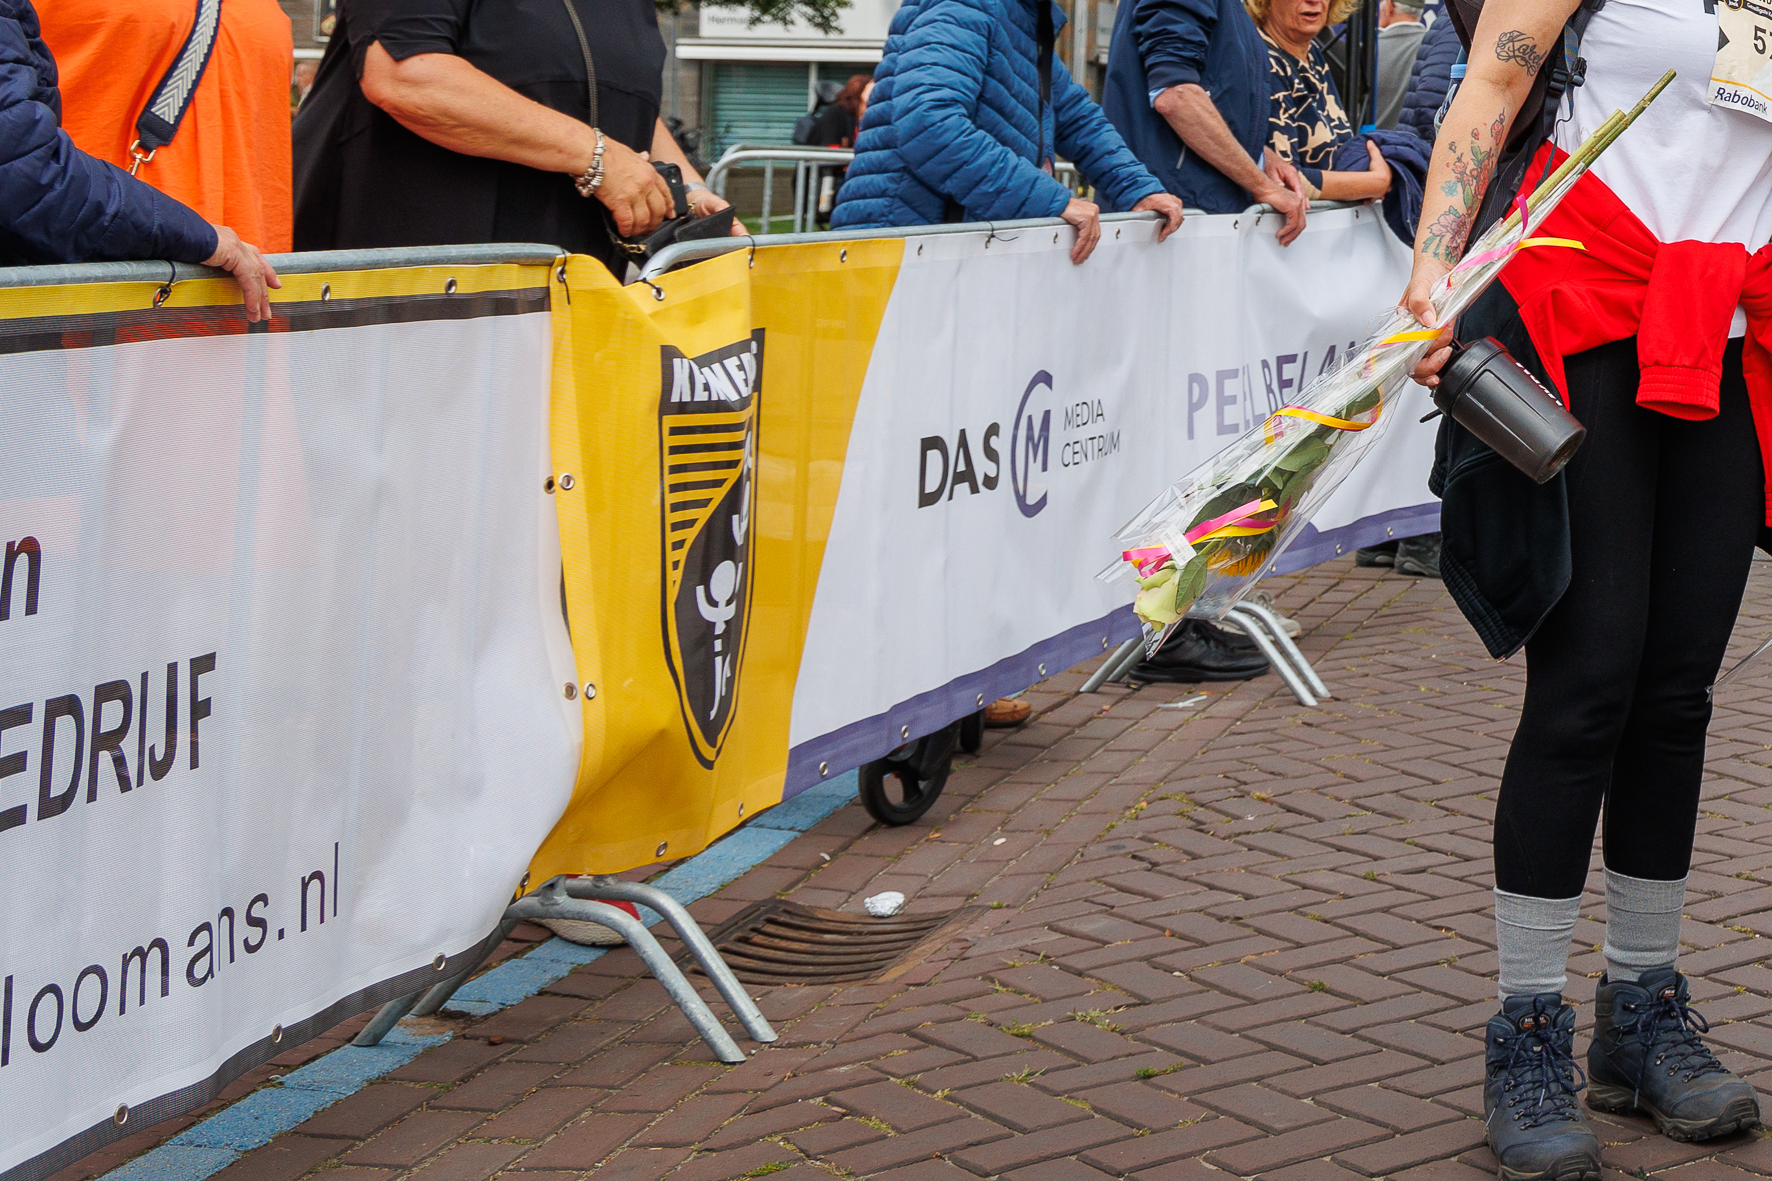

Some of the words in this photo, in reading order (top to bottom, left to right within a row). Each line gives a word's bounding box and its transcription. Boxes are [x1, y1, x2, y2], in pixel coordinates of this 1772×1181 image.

[1716, 86, 1768, 116] Rabobank
[917, 421, 1000, 510] DAS
[1063, 398, 1106, 432] MEDIA
[1061, 428, 1122, 468] CENTRUM
